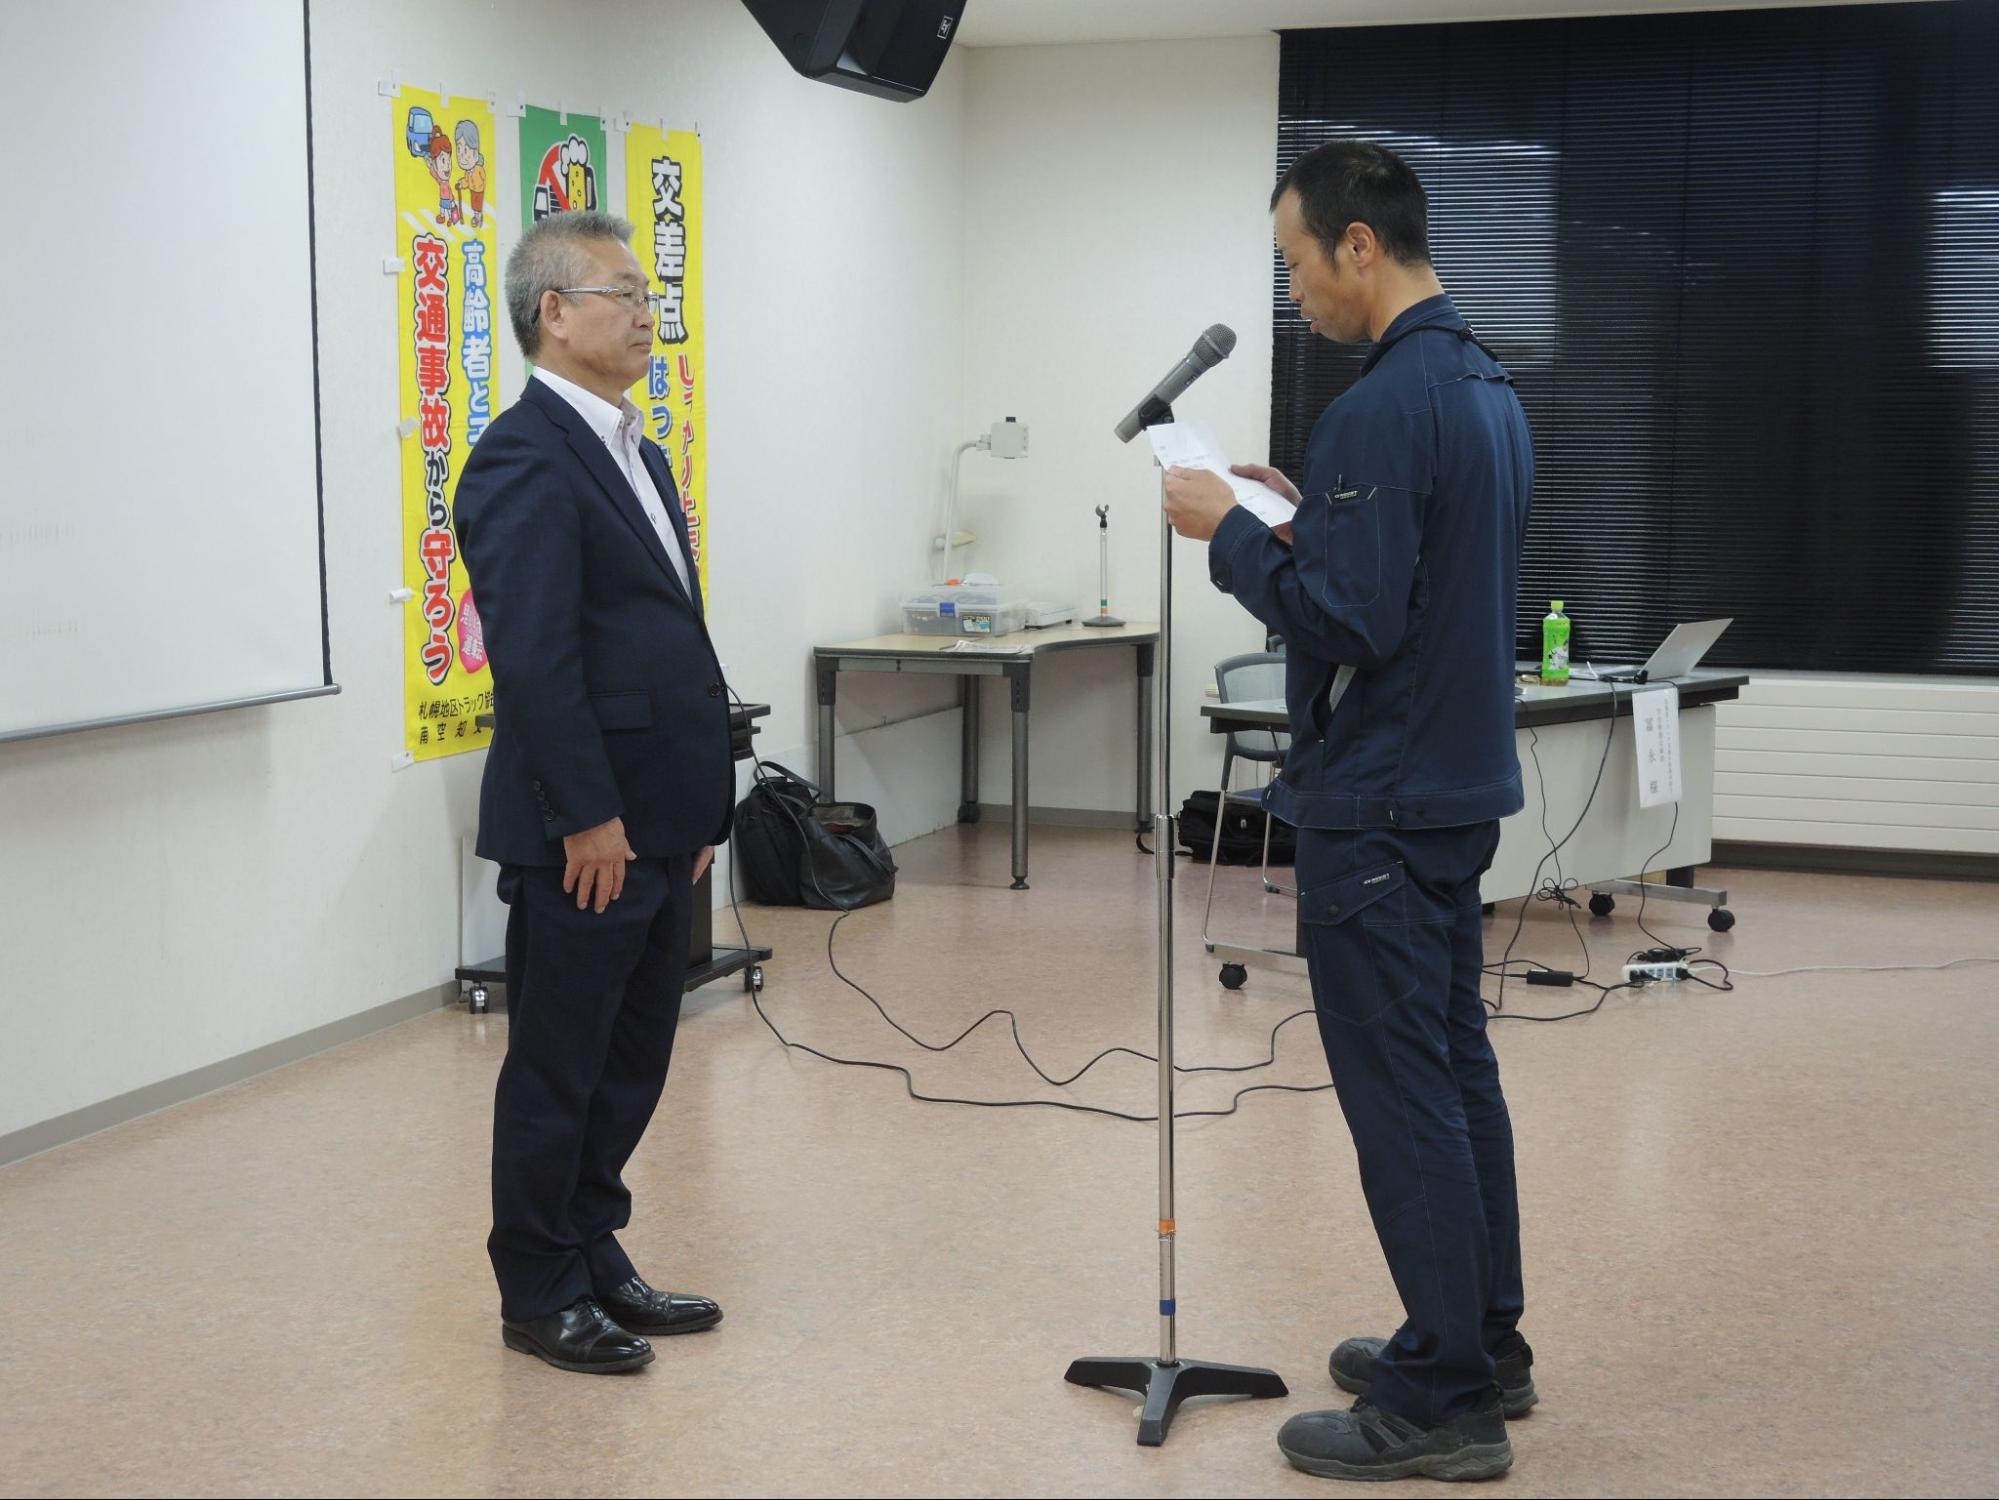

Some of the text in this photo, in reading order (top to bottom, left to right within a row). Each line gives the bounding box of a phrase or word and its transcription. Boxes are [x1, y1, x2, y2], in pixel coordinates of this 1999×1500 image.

[651, 156, 688, 344] 交差点
[413, 232, 456, 686] 交通事故から守ろう
